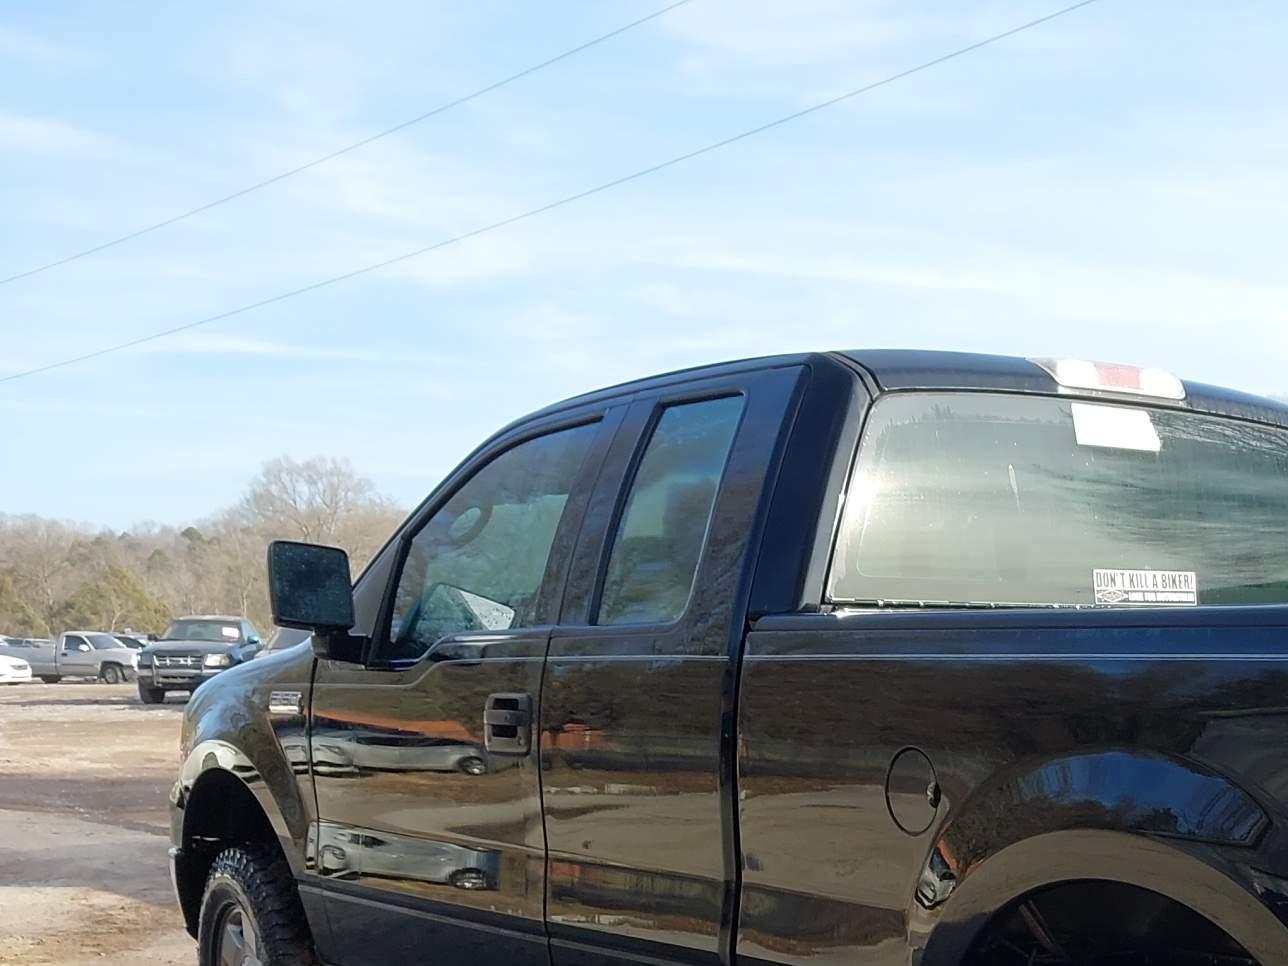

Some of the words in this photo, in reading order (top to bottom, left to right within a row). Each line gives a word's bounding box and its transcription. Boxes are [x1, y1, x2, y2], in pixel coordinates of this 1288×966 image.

[1096, 572, 1125, 588] DON'T
[1129, 573, 1149, 588] KILL
[1152, 574, 1159, 588] A
[1161, 574, 1194, 590] BIKER!
